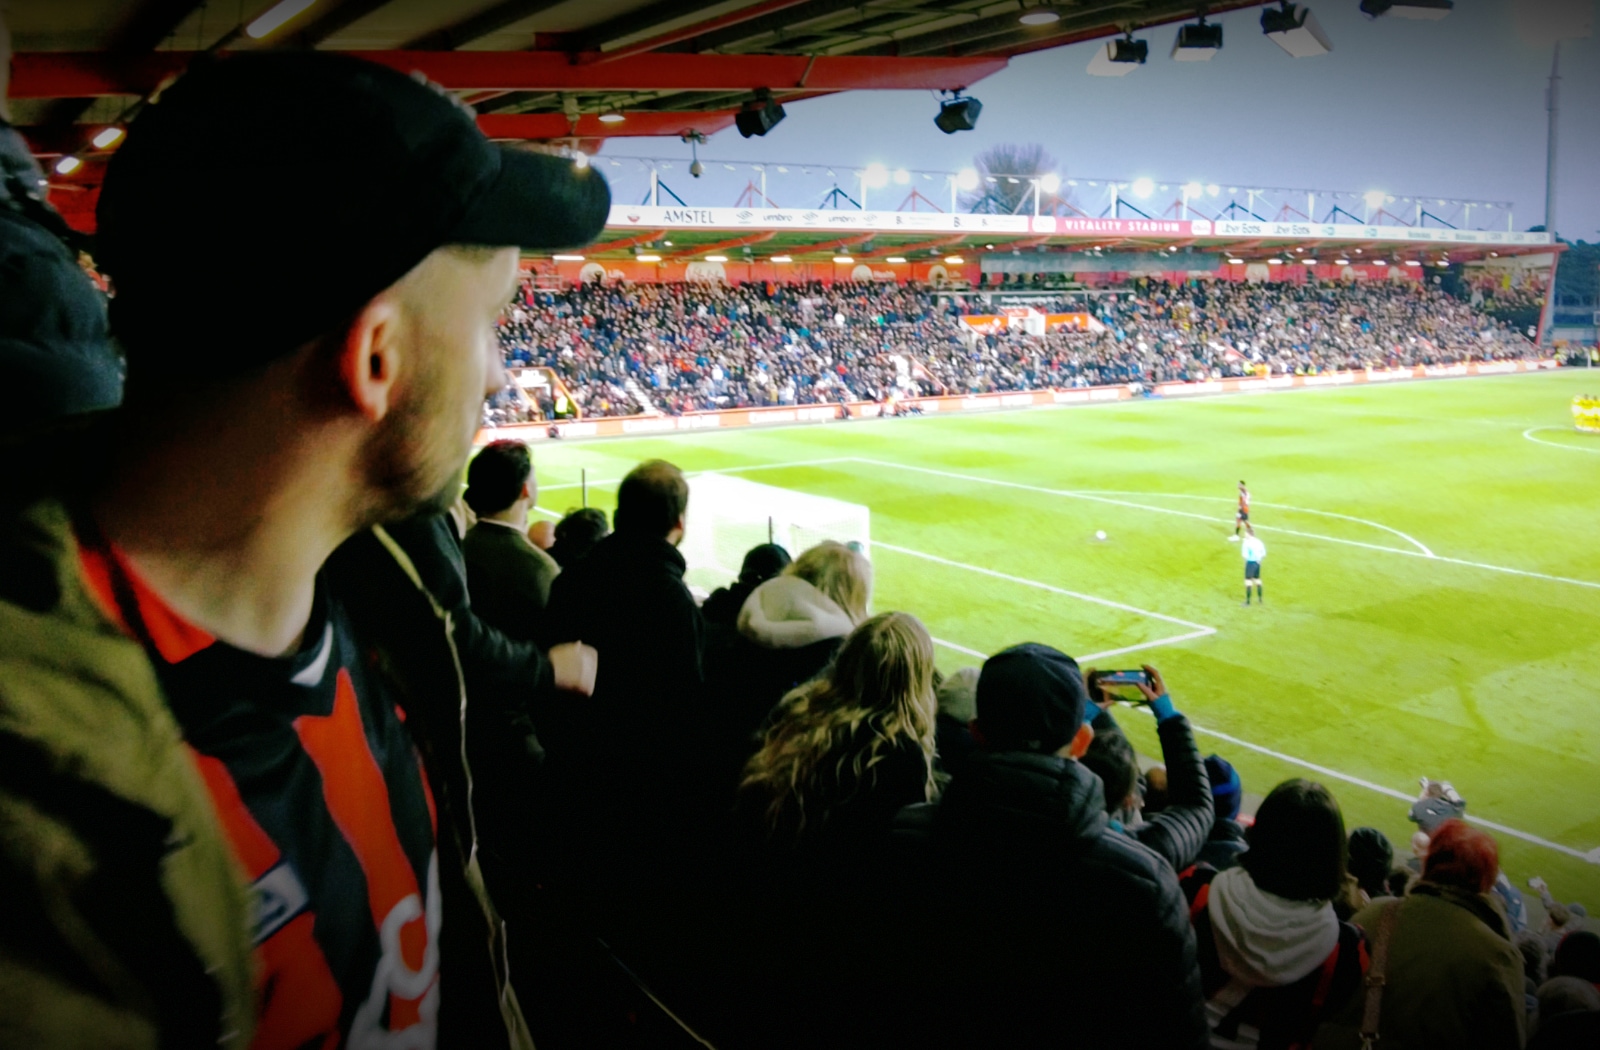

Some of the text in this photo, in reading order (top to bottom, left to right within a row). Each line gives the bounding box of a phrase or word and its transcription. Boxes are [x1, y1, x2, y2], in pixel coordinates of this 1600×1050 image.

[663, 209, 715, 224] AMSTEL
[762, 213, 793, 222] umbro
[1065, 219, 1122, 231] VITALITY
[1128, 220, 1180, 232] STADIUM
